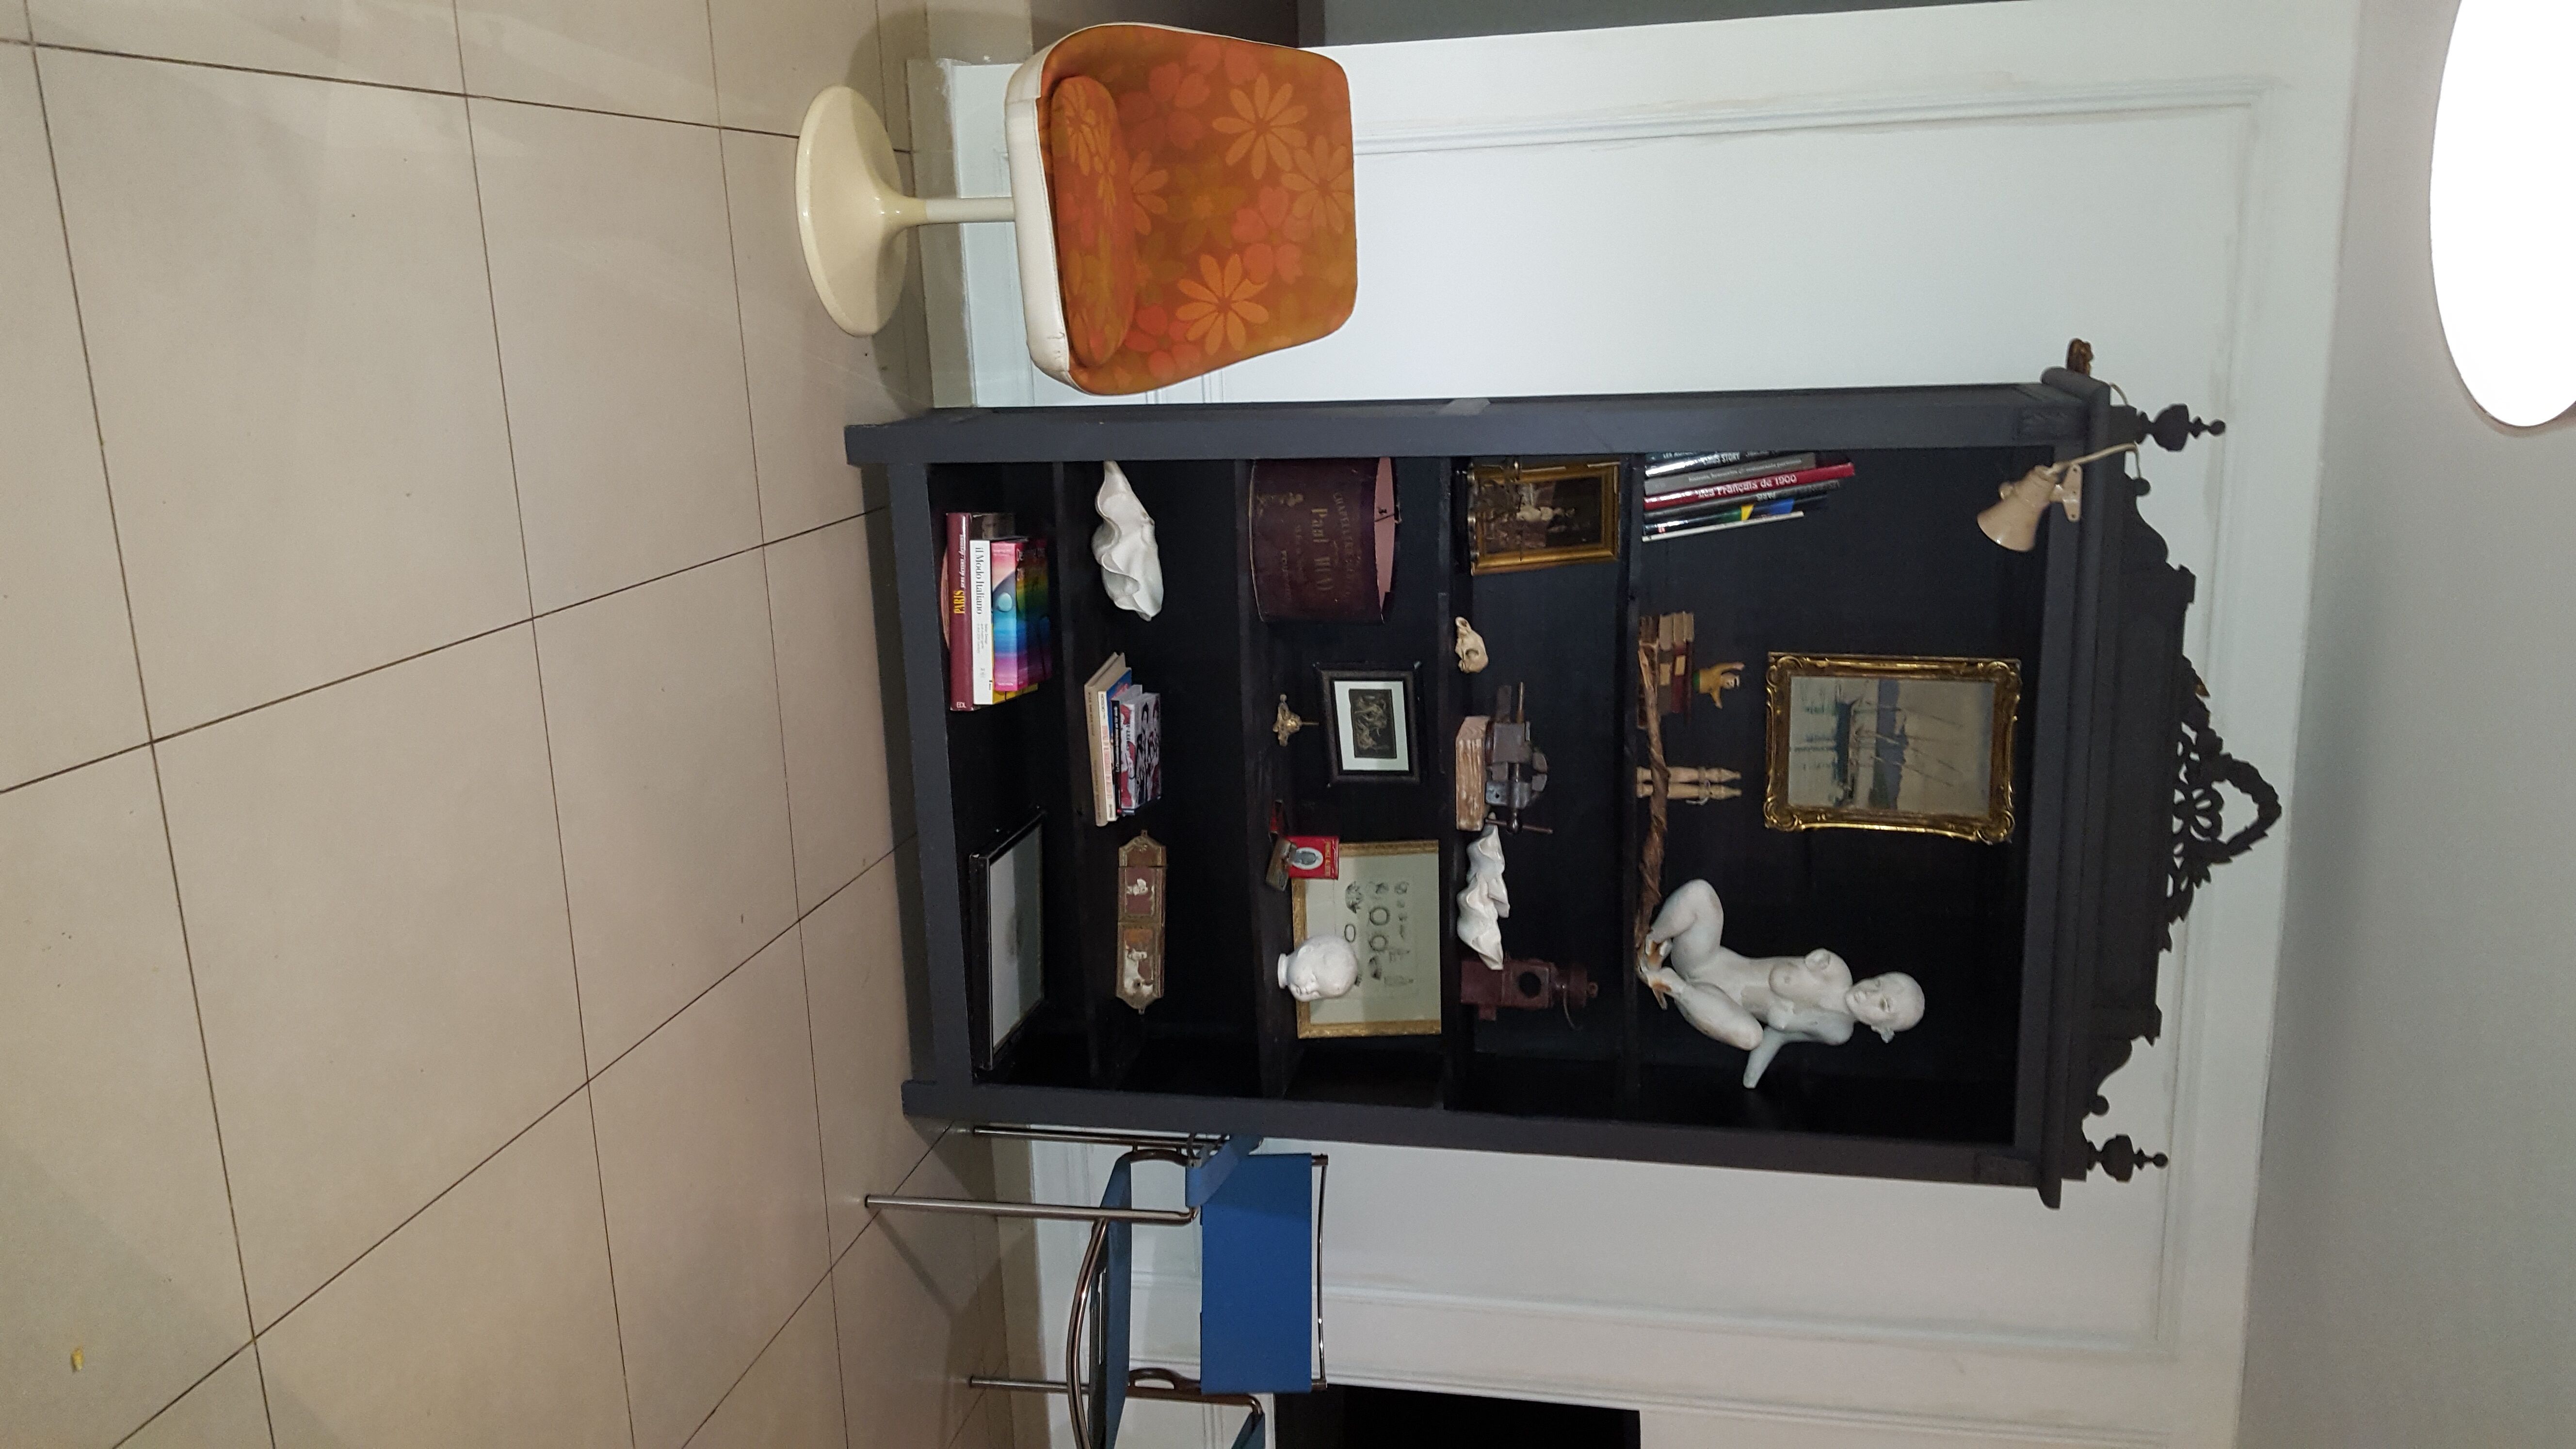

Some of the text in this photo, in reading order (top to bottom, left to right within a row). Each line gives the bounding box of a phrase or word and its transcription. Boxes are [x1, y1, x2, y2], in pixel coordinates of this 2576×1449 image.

[1717, 482, 1757, 496] Français
[1760, 479, 1773, 487] de
[1776, 475, 1798, 485] 1900
[975, 555, 984, 580] Modo
[953, 590, 965, 614] PARIS
[976, 581, 985, 615] Italiano
